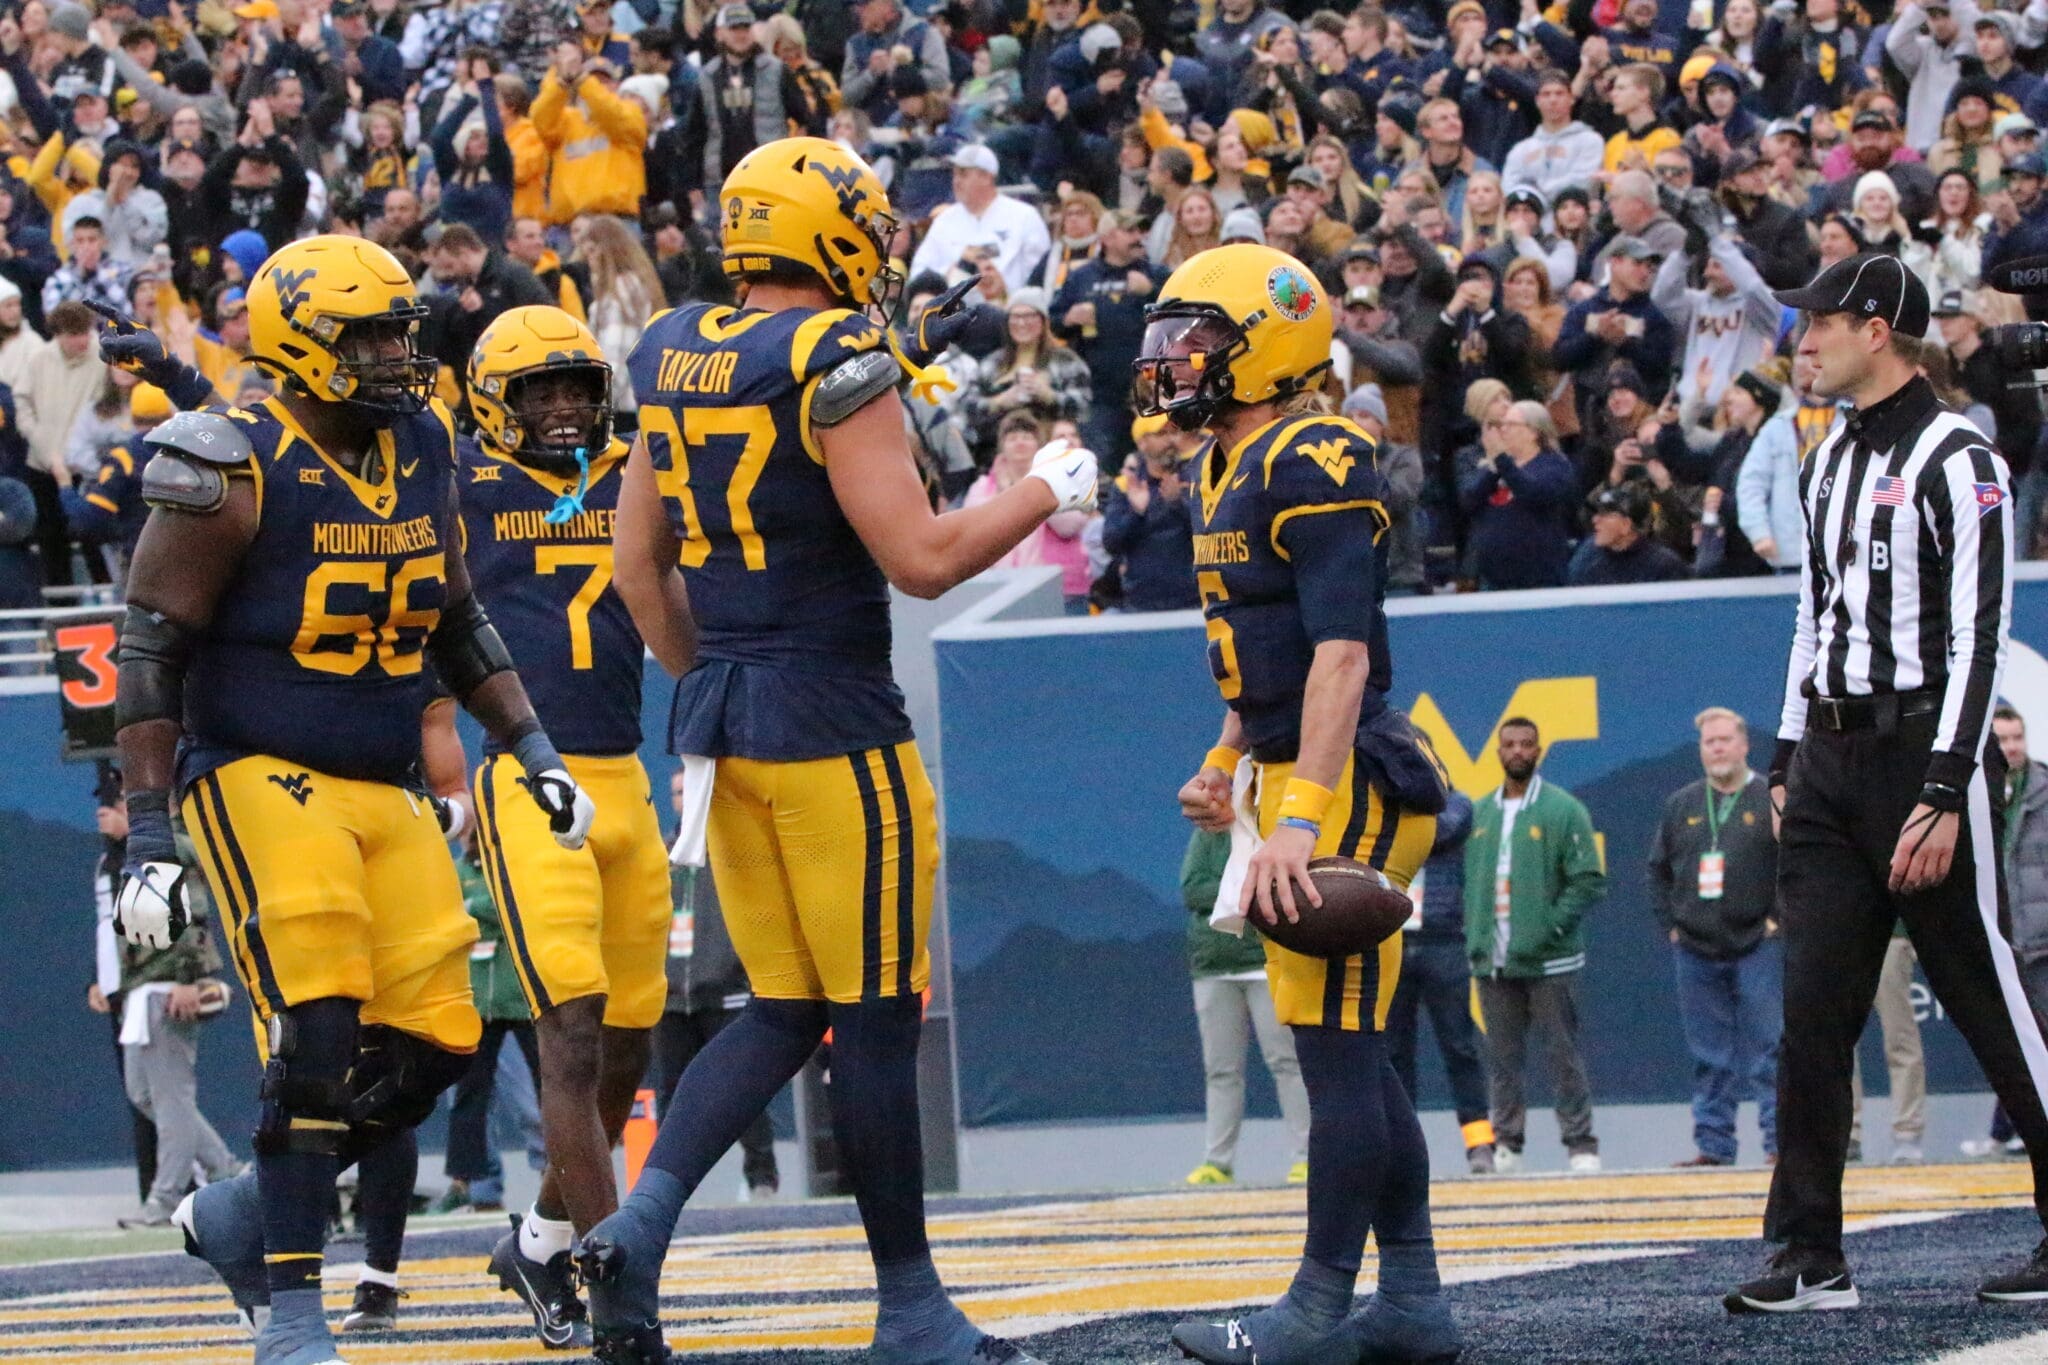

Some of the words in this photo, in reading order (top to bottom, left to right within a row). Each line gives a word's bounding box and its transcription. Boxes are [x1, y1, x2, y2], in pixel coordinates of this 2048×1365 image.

[1864, 298, 1878, 312] S
[656, 348, 738, 394] TAYLOR
[640, 404, 778, 571] 87
[1819, 477, 1833, 498] S
[313, 514, 437, 555] MOUNTAINEERS
[1871, 540, 1889, 571] B
[289, 552, 447, 677] 66
[535, 545, 614, 670] 7
[56, 624, 118, 708] 3
